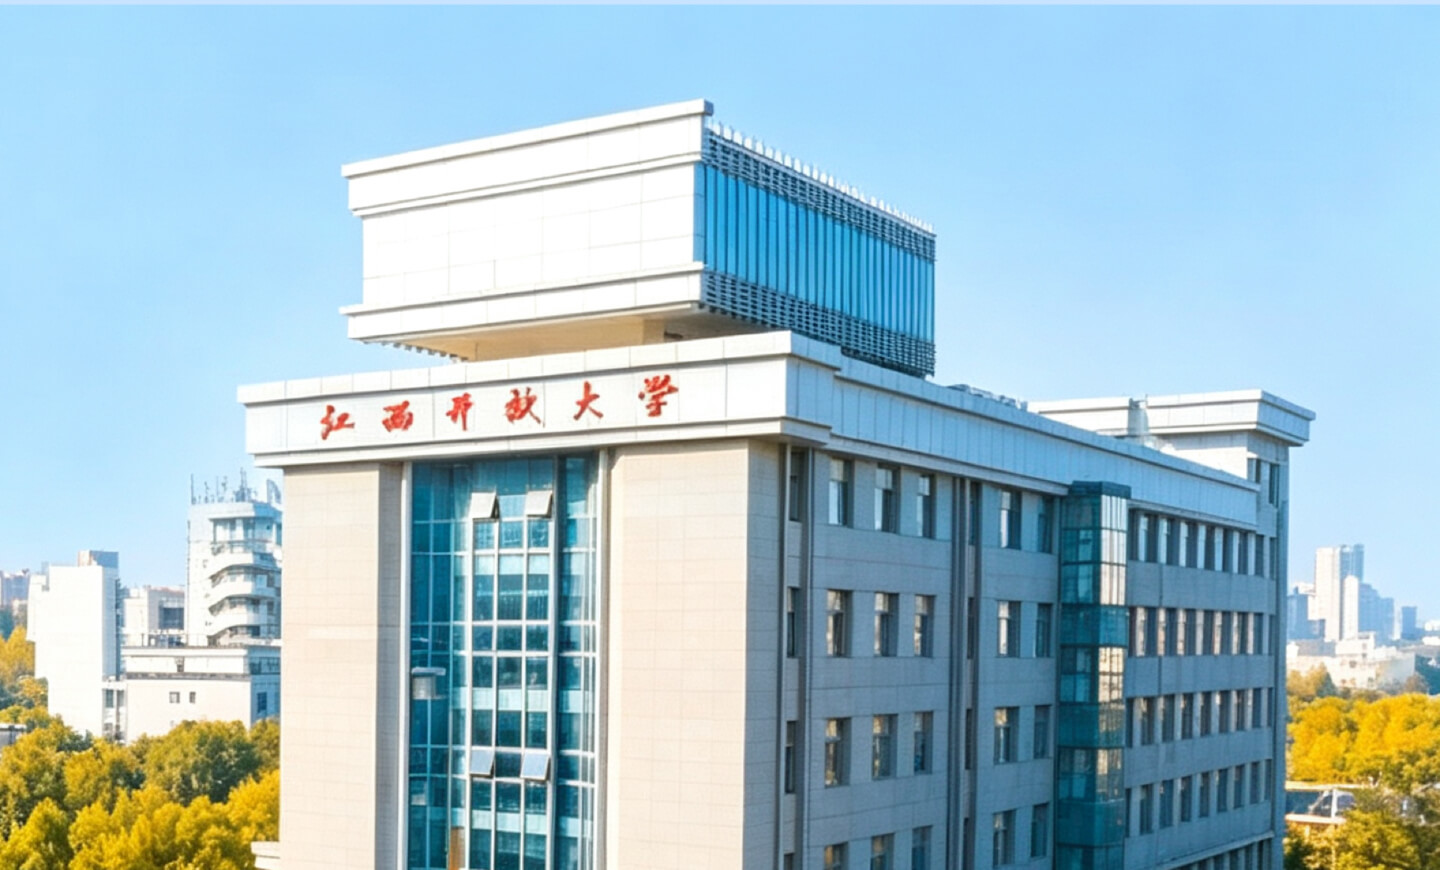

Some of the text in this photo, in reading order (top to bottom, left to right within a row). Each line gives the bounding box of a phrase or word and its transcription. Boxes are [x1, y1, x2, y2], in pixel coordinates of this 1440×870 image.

[319, 374, 679, 440] 江西开放大学
